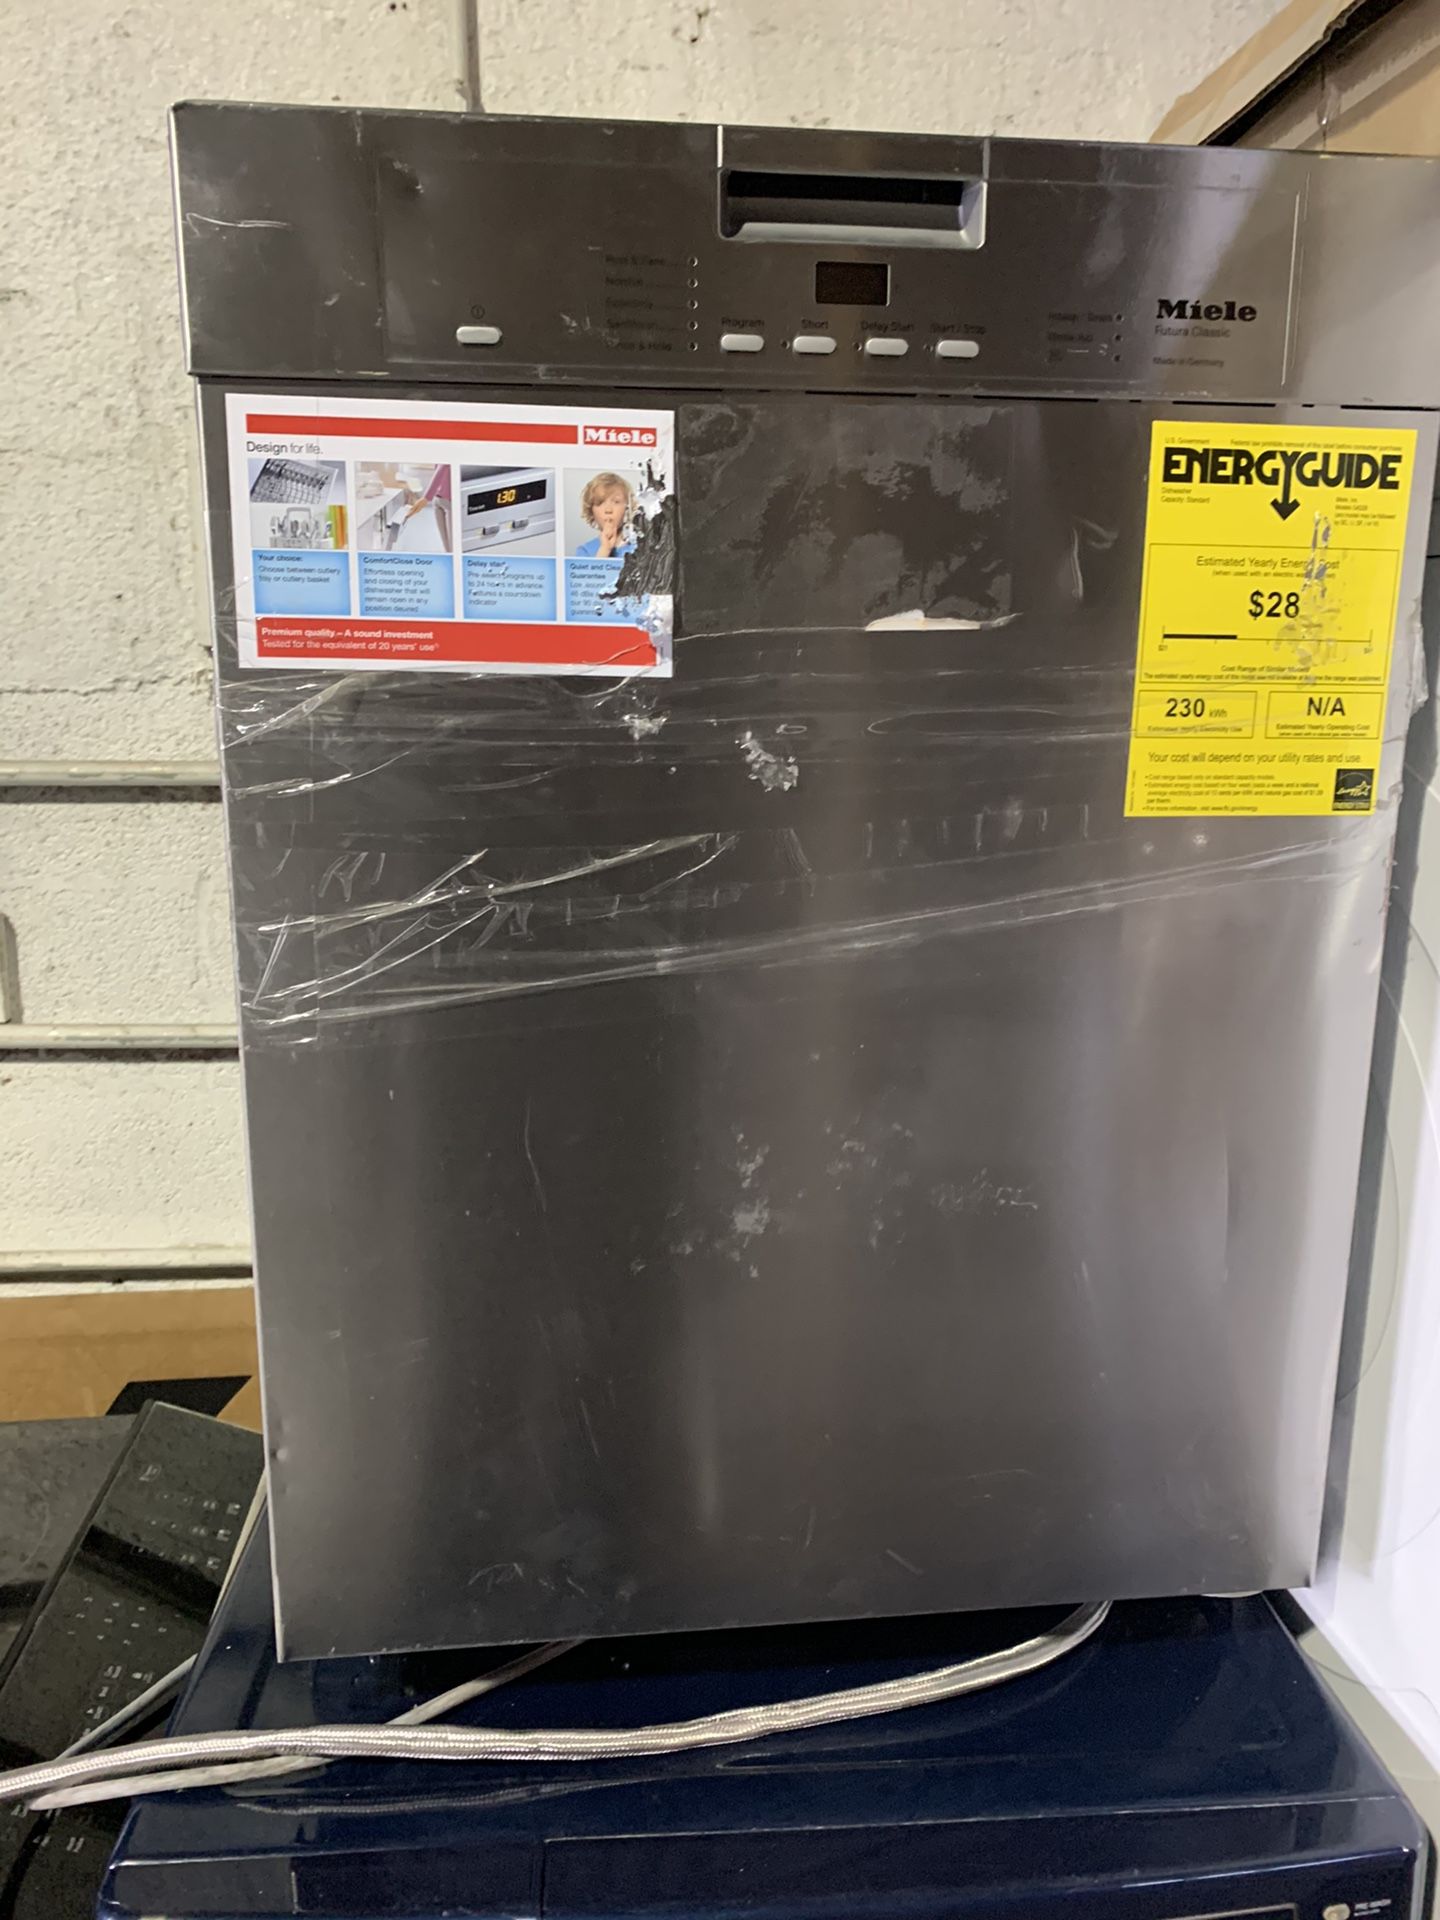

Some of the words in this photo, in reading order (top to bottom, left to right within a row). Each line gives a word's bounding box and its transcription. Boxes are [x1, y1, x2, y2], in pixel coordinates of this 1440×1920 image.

[1156, 299, 1257, 322] Miele
[721, 317, 765, 330] Program
[801, 318, 829, 330] Short
[1154, 325, 1189, 337] Futura
[584, 427, 656, 445] Miele
[246, 440, 288, 456] Design
[290, 441, 304, 454] for
[305, 442, 324, 455] life.
[1196, 556, 1246, 568] Estimated
[1247, 557, 1278, 570] Yearly
[1248, 590, 1301, 620] $28
[261, 627, 303, 637] Premium
[304, 628, 335, 639] quality
[344, 630, 352, 638] A
[353, 629, 382, 638] sound
[383, 630, 434, 640] investment
[262, 639, 291, 649] Tested
[292, 640, 305, 649] for
[306, 640, 321, 650] the
[322, 641, 367, 651] equivalent
[368, 641, 377, 650] of
[379, 642, 390, 651] 20
[1165, 698, 1206, 718] 230
[1305, 696, 1346, 717] N/A
[1148, 752, 1169, 764] Your
[1171, 753, 1190, 763] cost
[1192, 752, 1207, 763] will
[1208, 752, 1242, 766] depend
[1243, 754, 1255, 764] on
[1256, 754, 1276, 767] your
[1277, 752, 1301, 766] utility
[1302, 753, 1325, 764] rates
[1327, 752, 1343, 764] and
